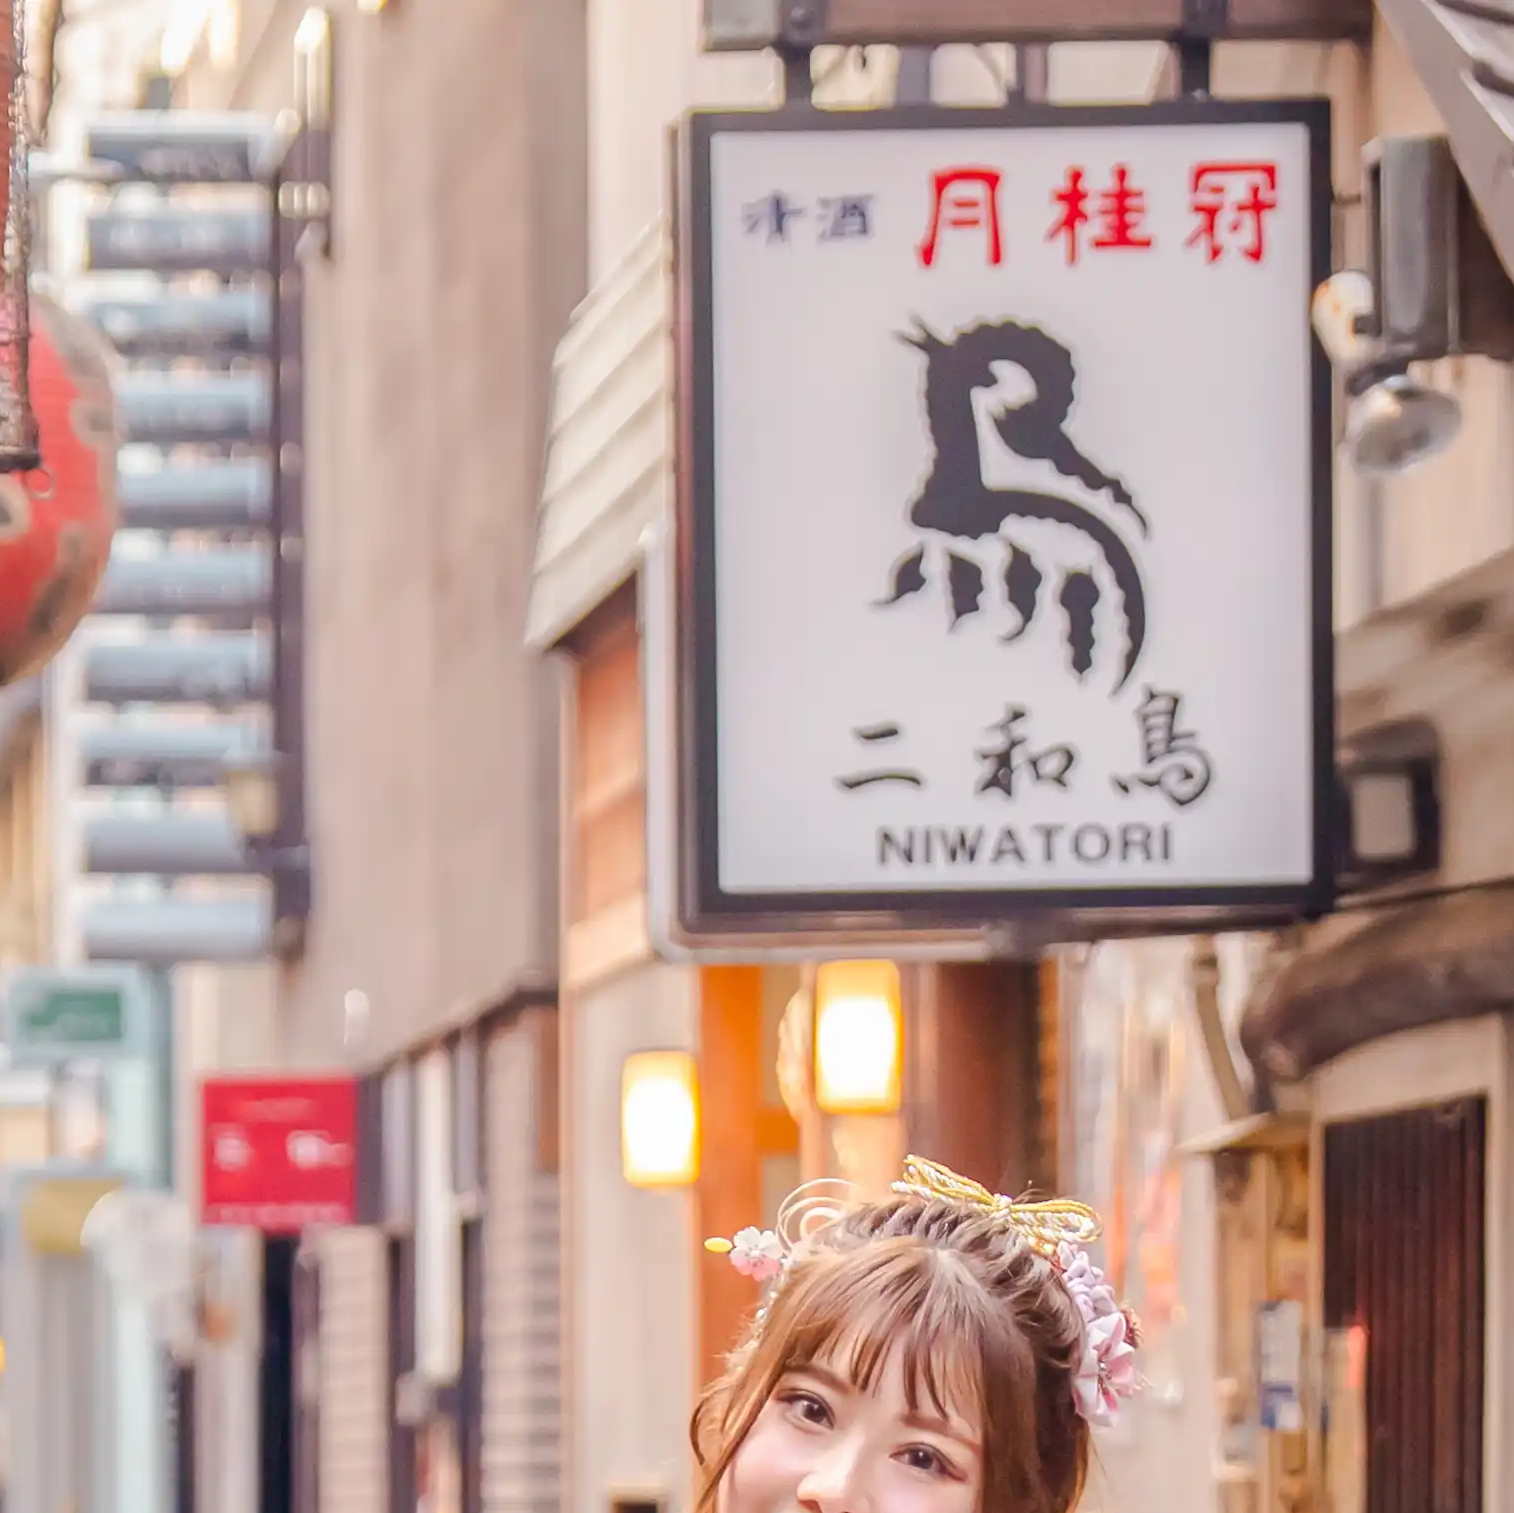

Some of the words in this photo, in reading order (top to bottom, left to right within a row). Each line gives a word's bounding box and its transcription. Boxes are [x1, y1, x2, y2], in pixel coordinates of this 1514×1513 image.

[915, 161, 1279, 268] 月桂冠
[834, 684, 1213, 806] 二和鳥
[877, 821, 1175, 866] NIWATORI
